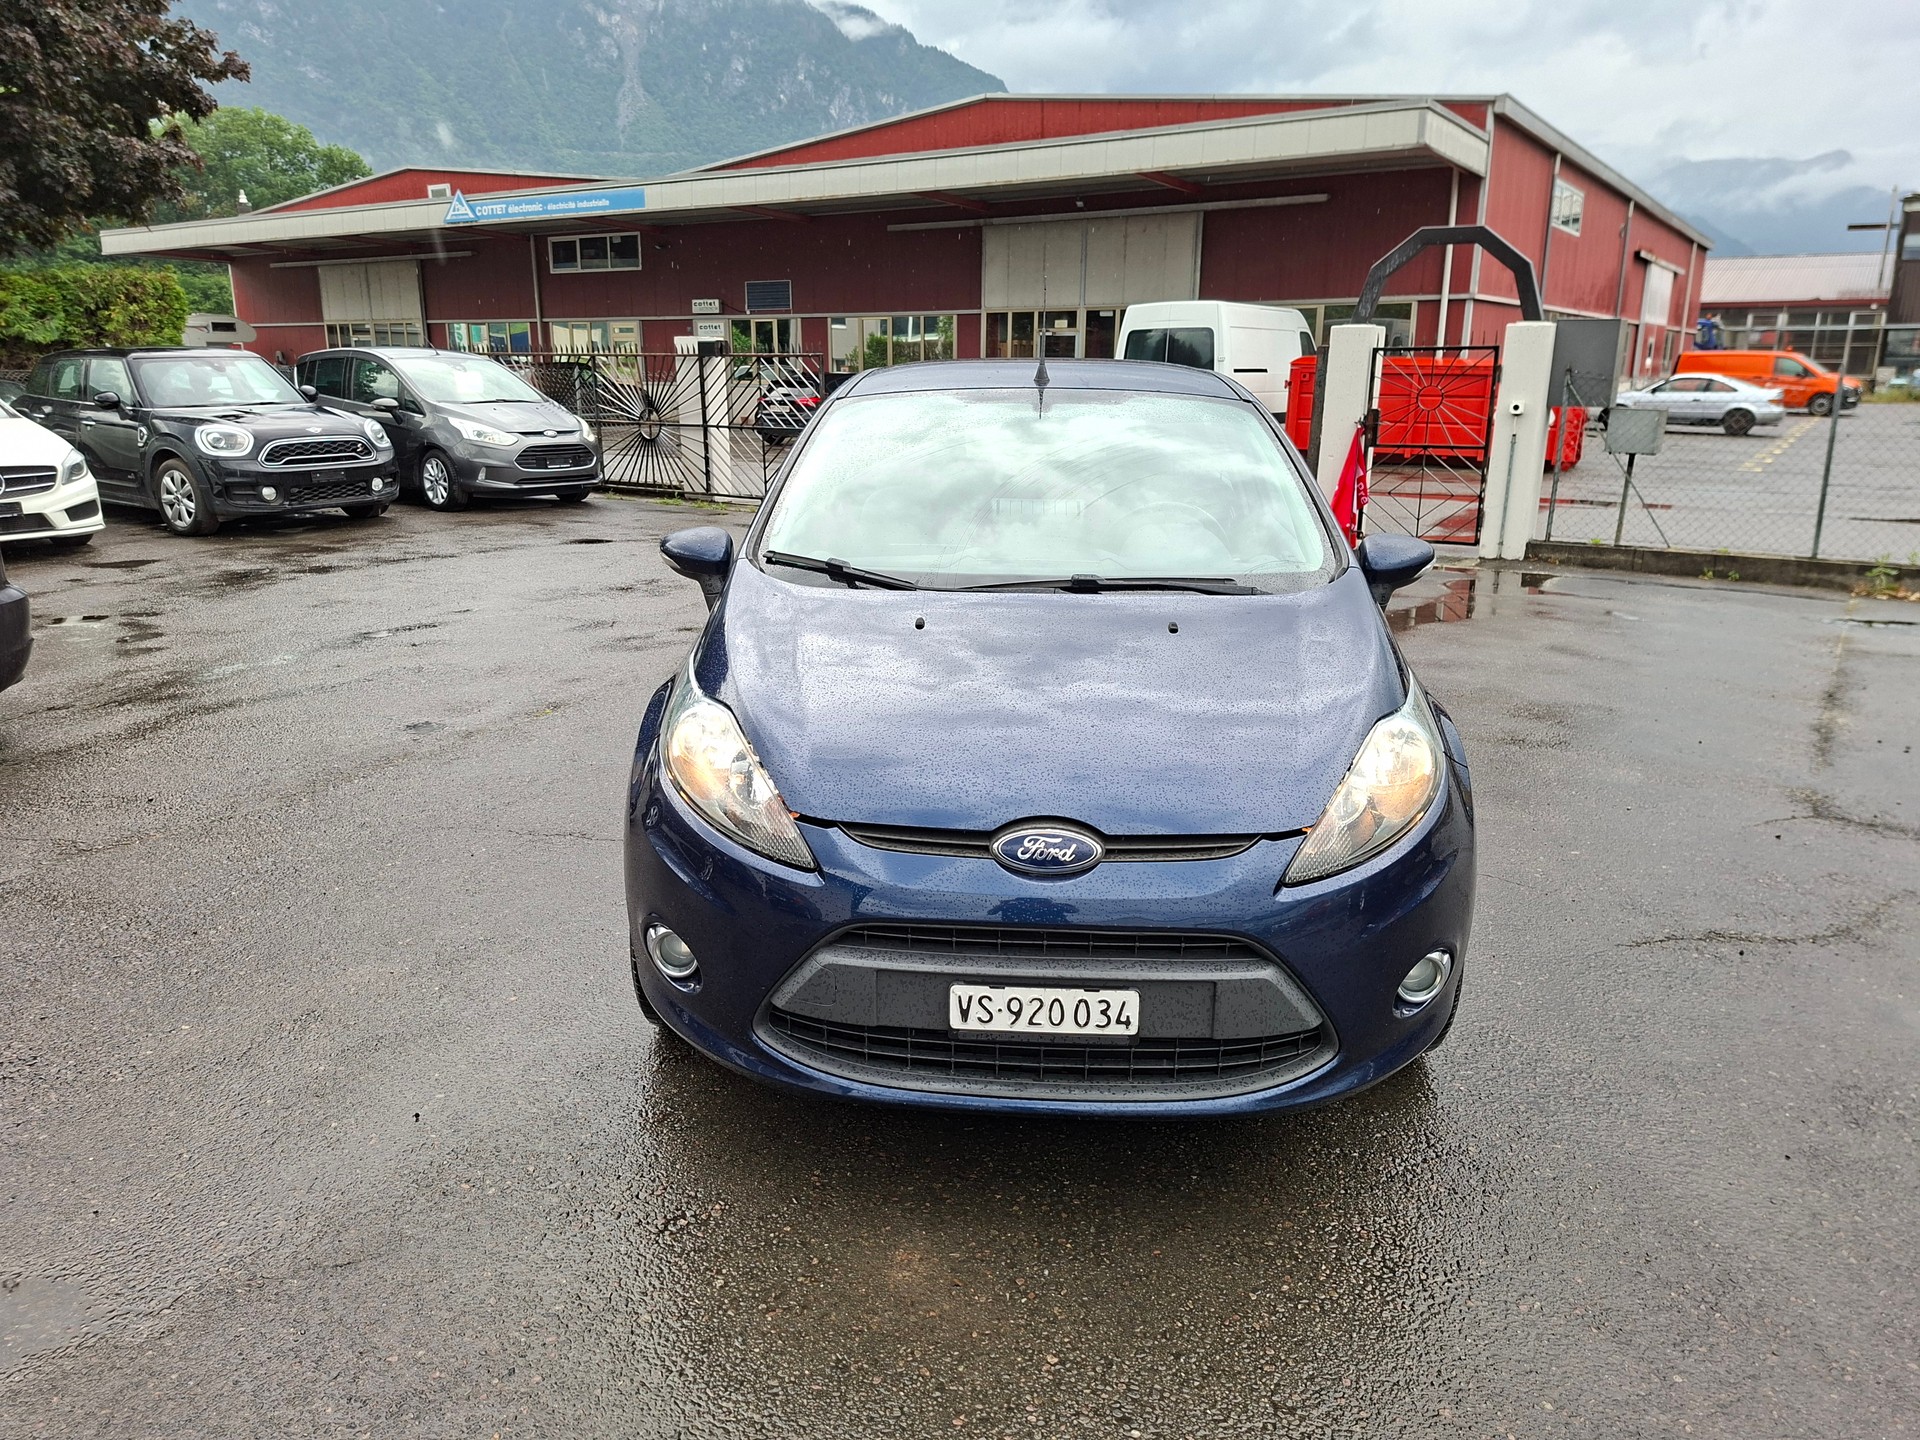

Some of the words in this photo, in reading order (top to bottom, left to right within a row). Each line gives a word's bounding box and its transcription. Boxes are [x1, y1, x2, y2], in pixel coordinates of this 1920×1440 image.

[475, 204, 506, 216] COTTET
[508, 201, 543, 213] électronic
[1017, 835, 1077, 861] Ford
